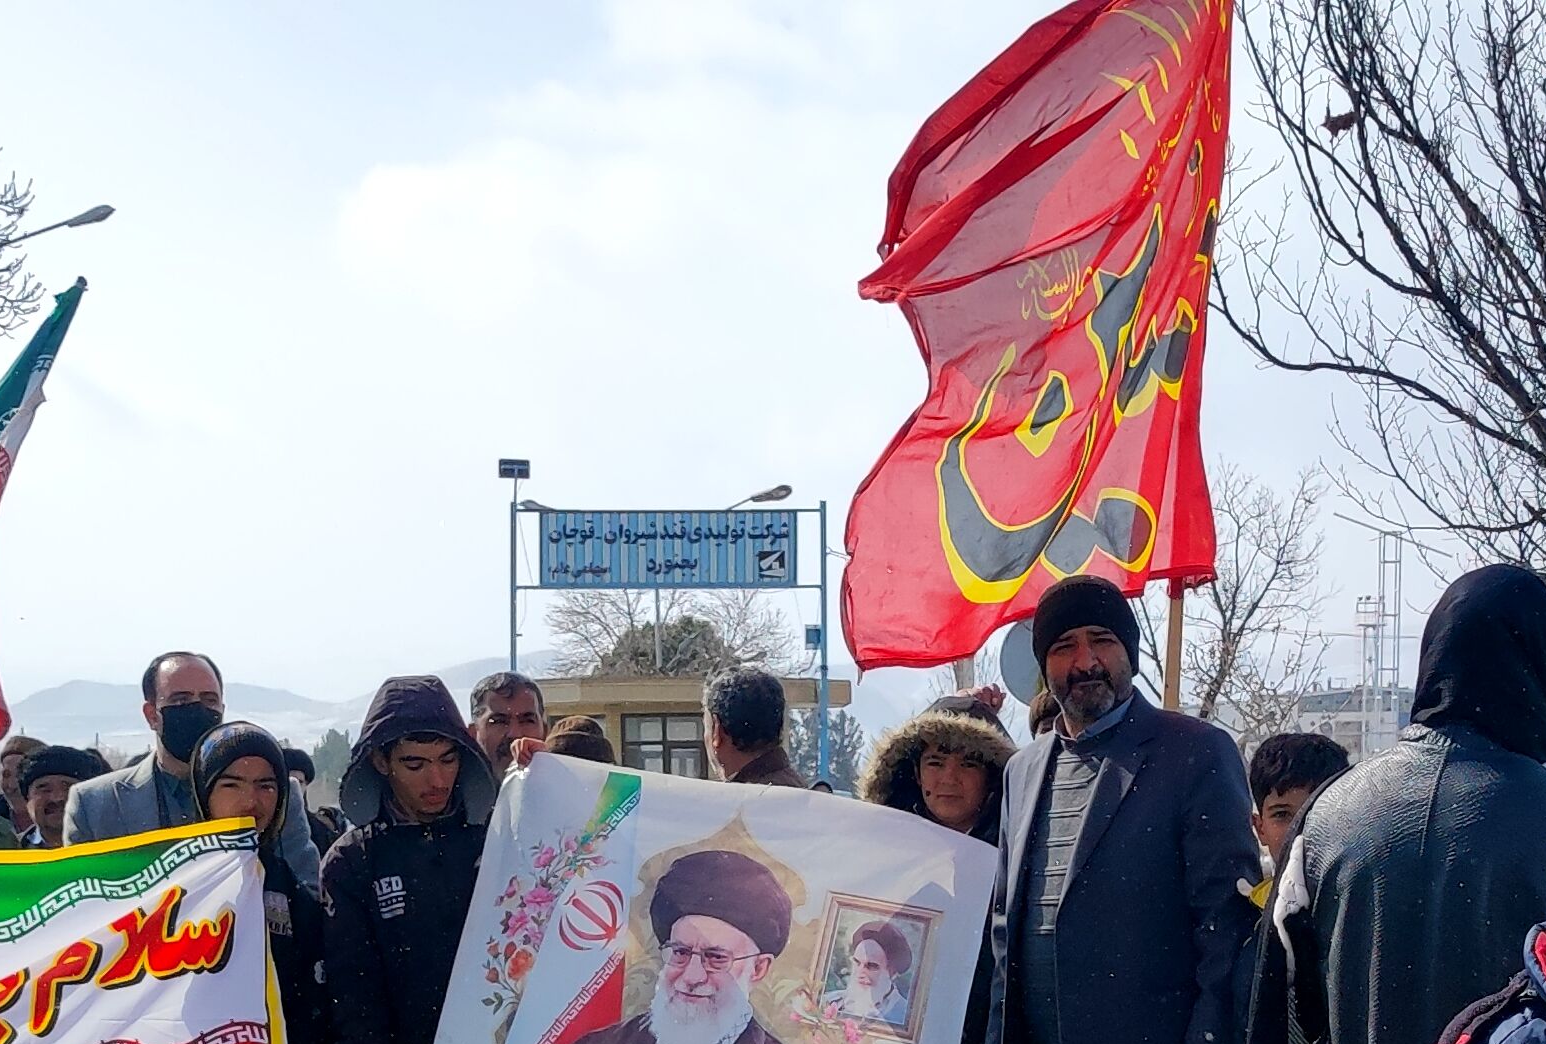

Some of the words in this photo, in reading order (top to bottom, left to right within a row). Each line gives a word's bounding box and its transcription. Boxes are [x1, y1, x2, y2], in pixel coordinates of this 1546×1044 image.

[549, 519, 595, 547] قوچان
[604, 521, 658, 546] شیروان
[660, 520, 687, 540] قند
[688, 520, 745, 547] تولیدی
[748, 521, 789, 545] شرکت
[647, 553, 698, 577] بجنورد
[29, 885, 236, 1037] سلام
